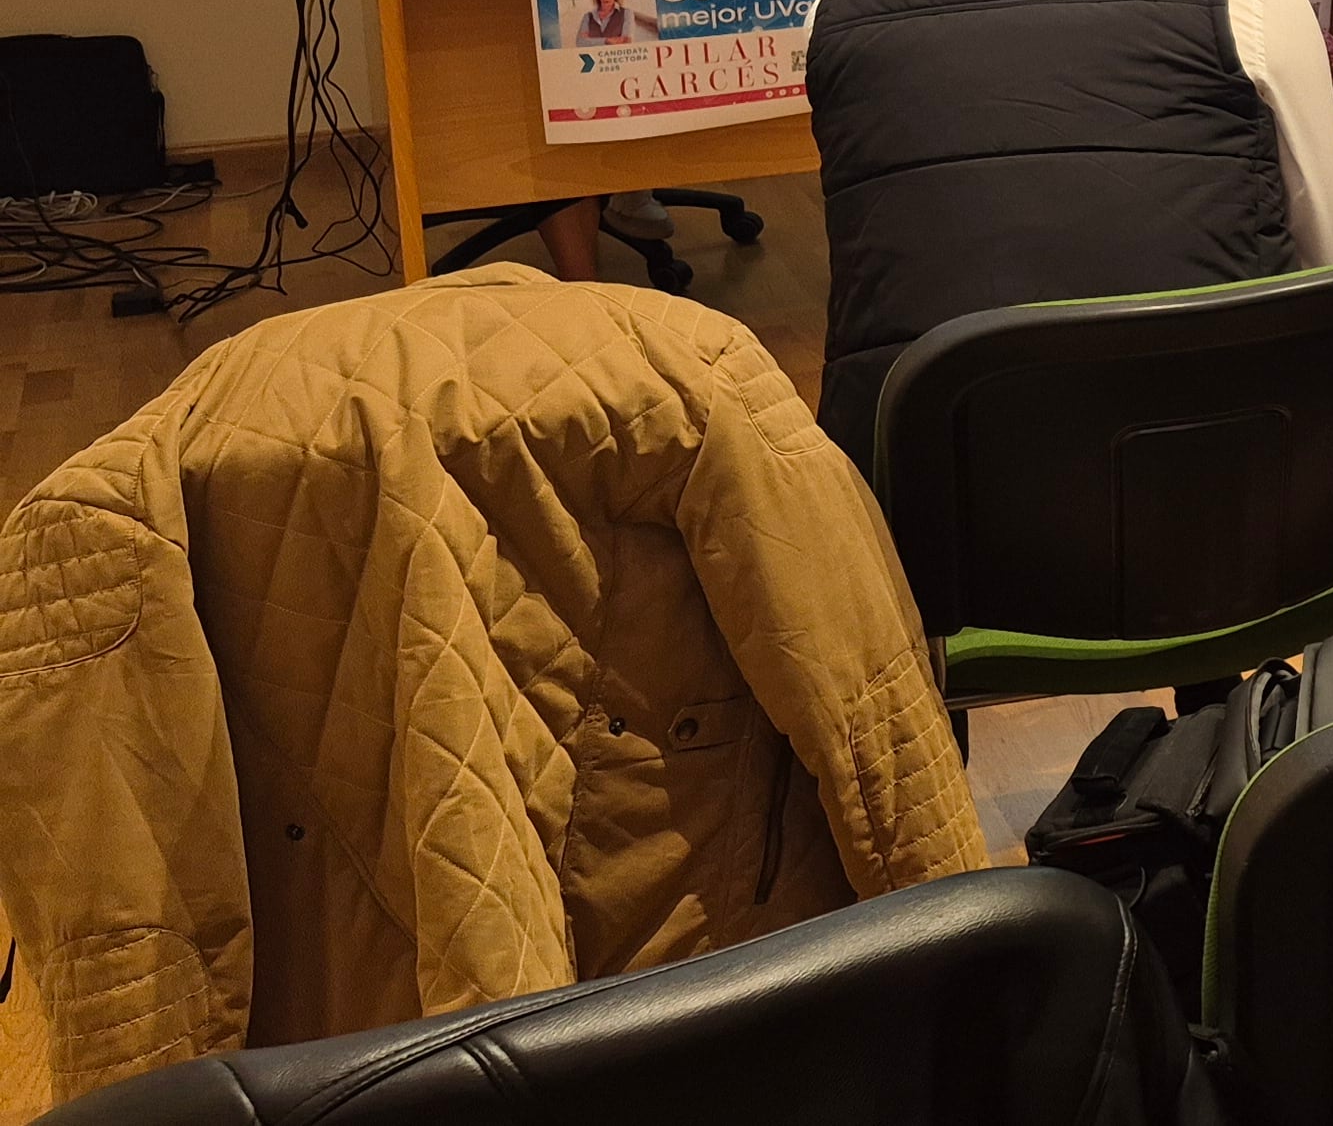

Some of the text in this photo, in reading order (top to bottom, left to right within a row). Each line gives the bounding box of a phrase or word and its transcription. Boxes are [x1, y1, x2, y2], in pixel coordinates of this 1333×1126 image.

[660, 3, 747, 30] mejor
[597, 46, 649, 58] CANDIDATA
[607, 55, 648, 64] RECTORA
[655, 34, 777, 69] PILAR
[619, 59, 780, 101] GARCÉS
